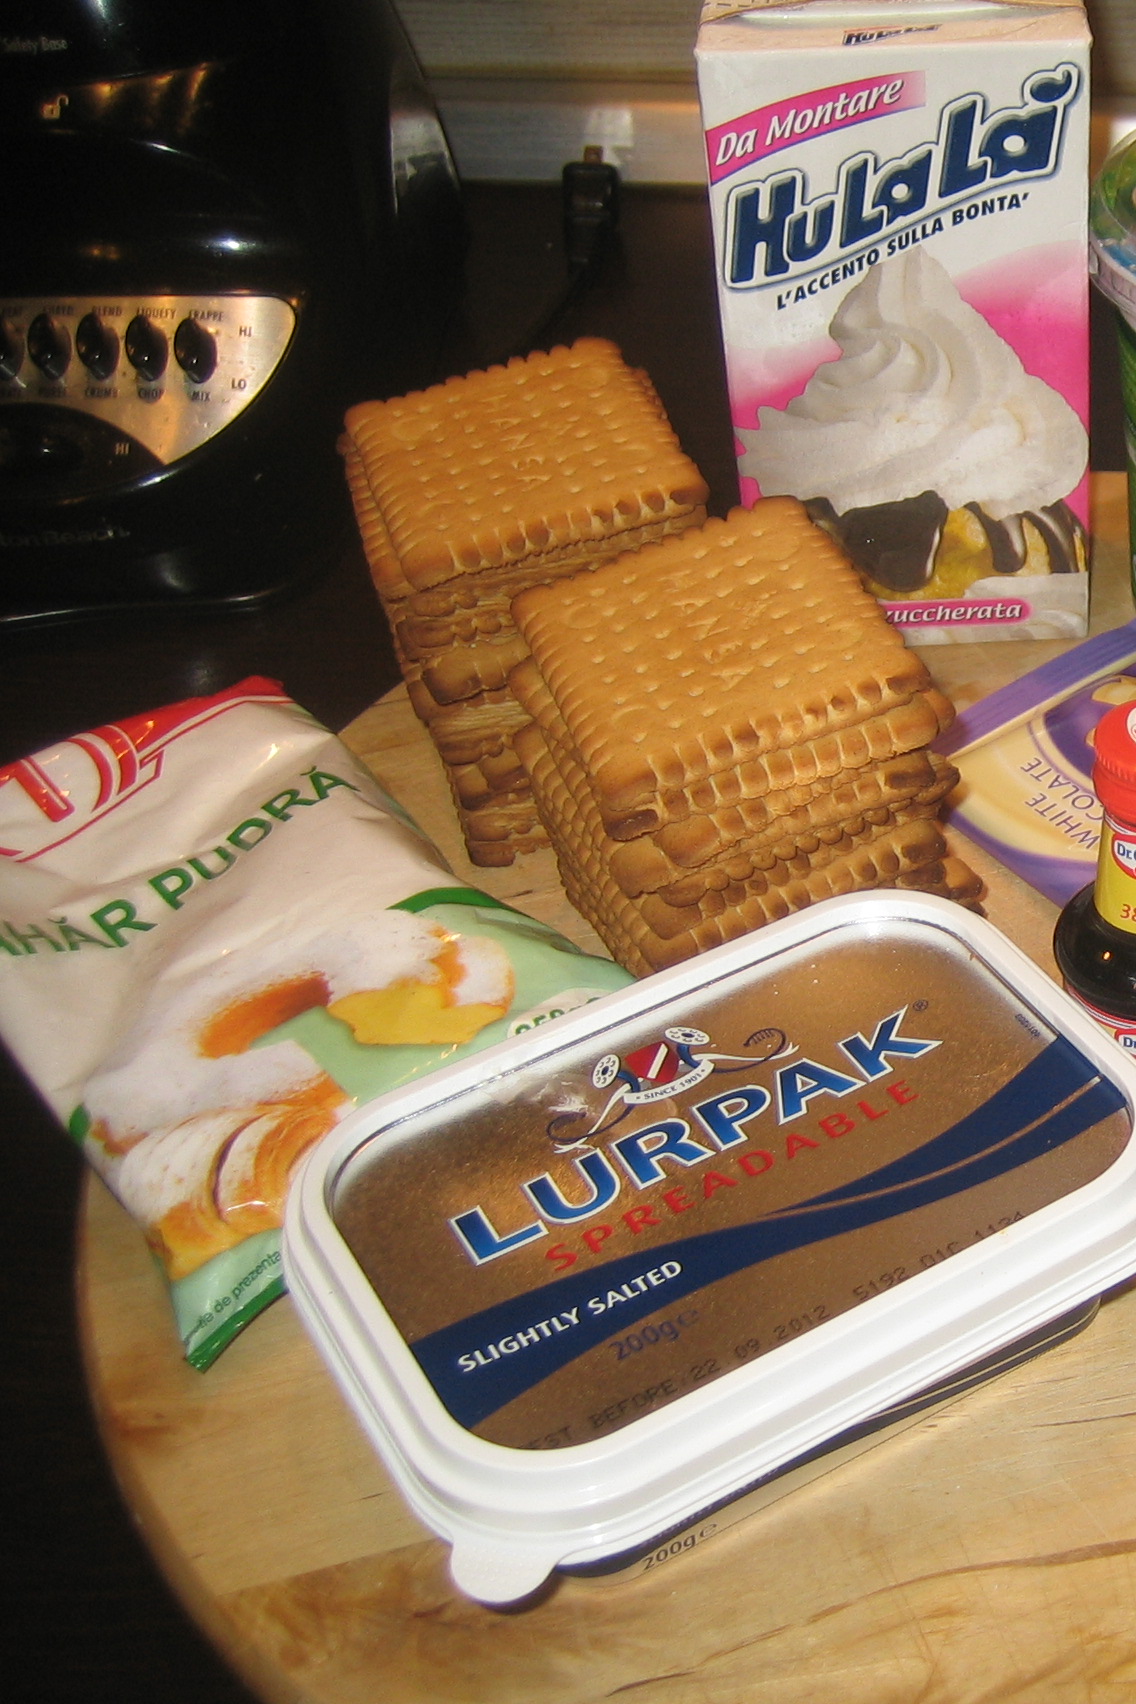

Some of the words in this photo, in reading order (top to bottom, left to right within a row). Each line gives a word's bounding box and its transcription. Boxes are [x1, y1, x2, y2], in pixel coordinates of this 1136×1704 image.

[41, 36, 68, 51] Base
[716, 131, 754, 166] Da
[766, 78, 904, 145] Montare
[776, 246, 880, 310] L'ACCENTO
[886, 216, 944, 257] SULLA
[952, 192, 1030, 226] BONTA'
[239, 325, 253, 338] HI
[231, 378, 247, 390] LO
[115, 442, 130, 455] HI
[148, 766, 361, 910] PUDRĂ
[1025, 793, 1100, 849] WHITE
[644, 1086, 677, 1100] SINCE
[679, 1072, 702, 1088] 1901
[447, 1004, 944, 1267] LURPAK
[544, 1079, 922, 1273] SPREADABLE
[214, 1296, 232, 1313] de
[457, 1308, 582, 1375] SLIGHTLY
[587, 1259, 684, 1316] SALTED
[773, 1304, 831, 1340] 2012
